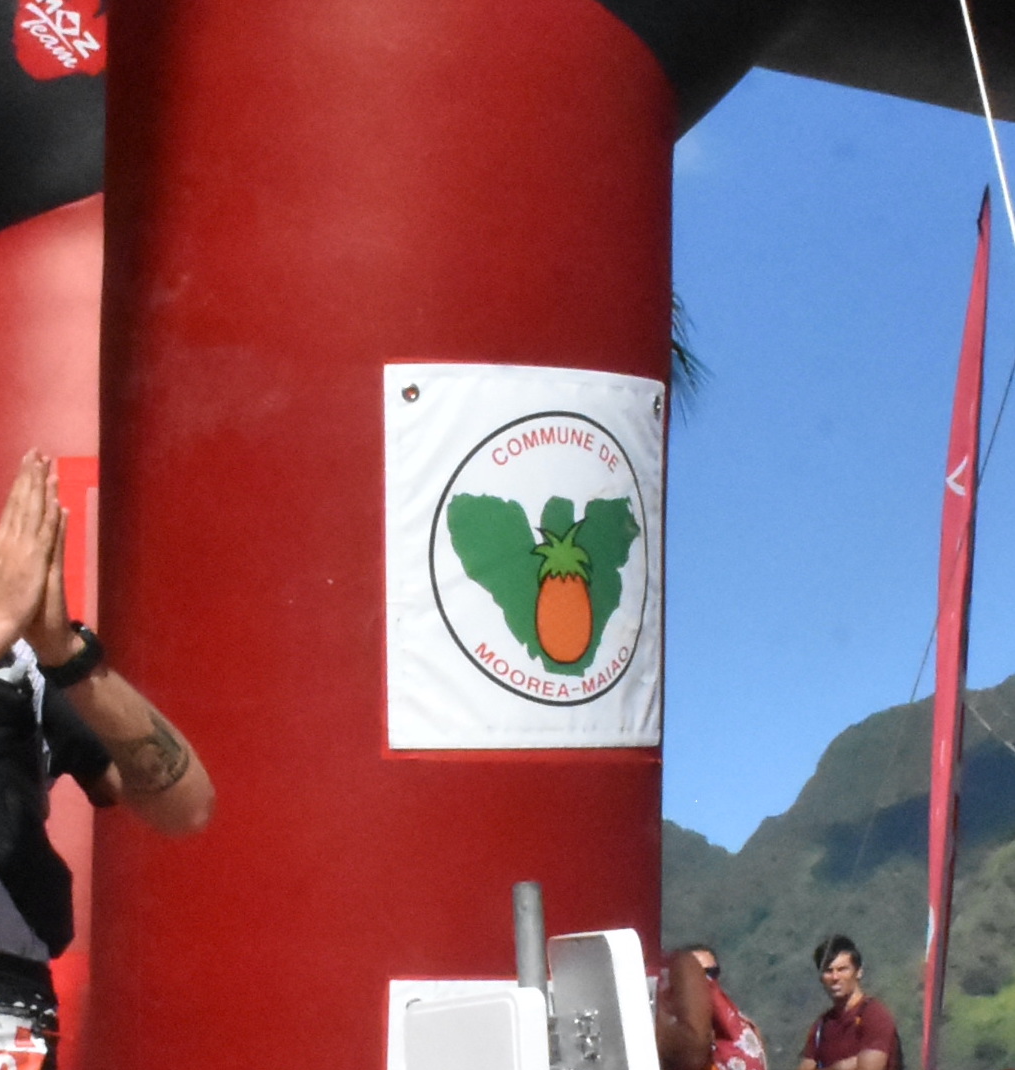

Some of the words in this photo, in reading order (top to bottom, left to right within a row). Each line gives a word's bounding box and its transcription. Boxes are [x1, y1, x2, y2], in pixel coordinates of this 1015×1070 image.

[491, 426, 595, 467] COMMUNE
[598, 443, 620, 473] DE
[474, 641, 630, 698] MOOREA-MAIAO
